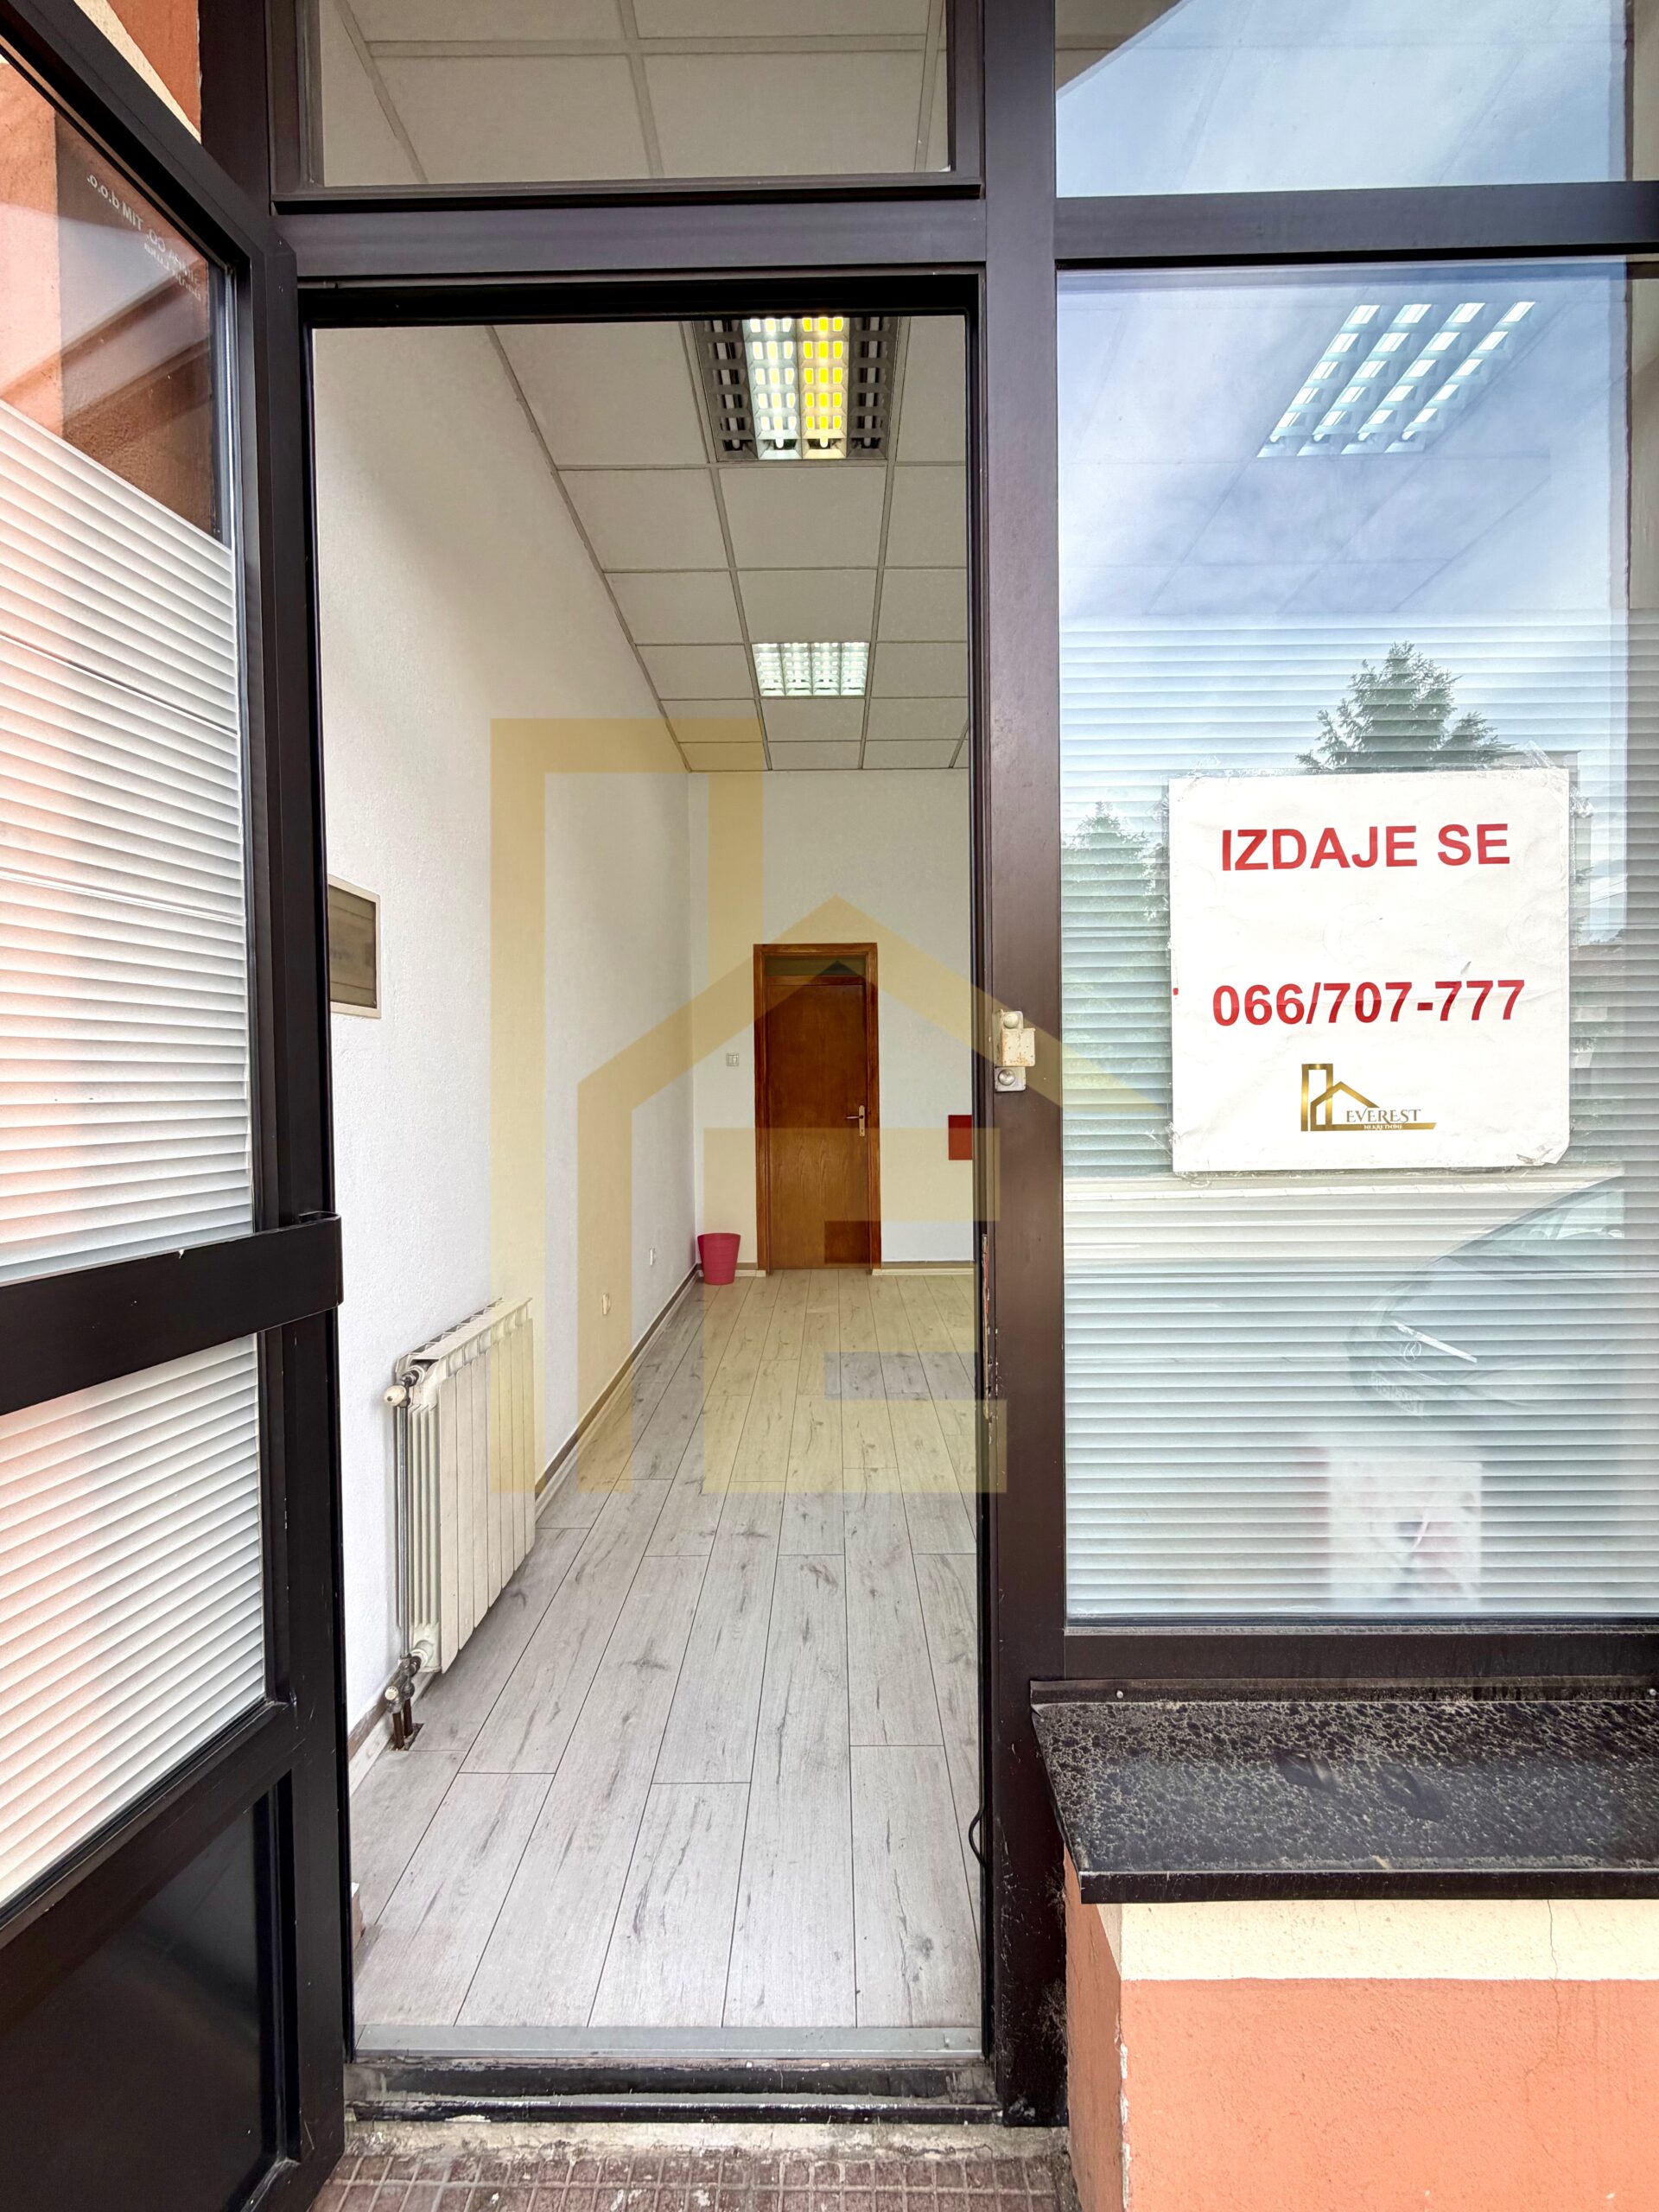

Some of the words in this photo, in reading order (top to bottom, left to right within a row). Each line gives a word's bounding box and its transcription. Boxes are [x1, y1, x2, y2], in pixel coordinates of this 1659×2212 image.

[1222, 825, 1417, 871] IZDAJE
[1437, 823, 1510, 866] SE
[1212, 979, 1525, 1026] 066/707-777
[1345, 1106, 1421, 1125] EVEREST
